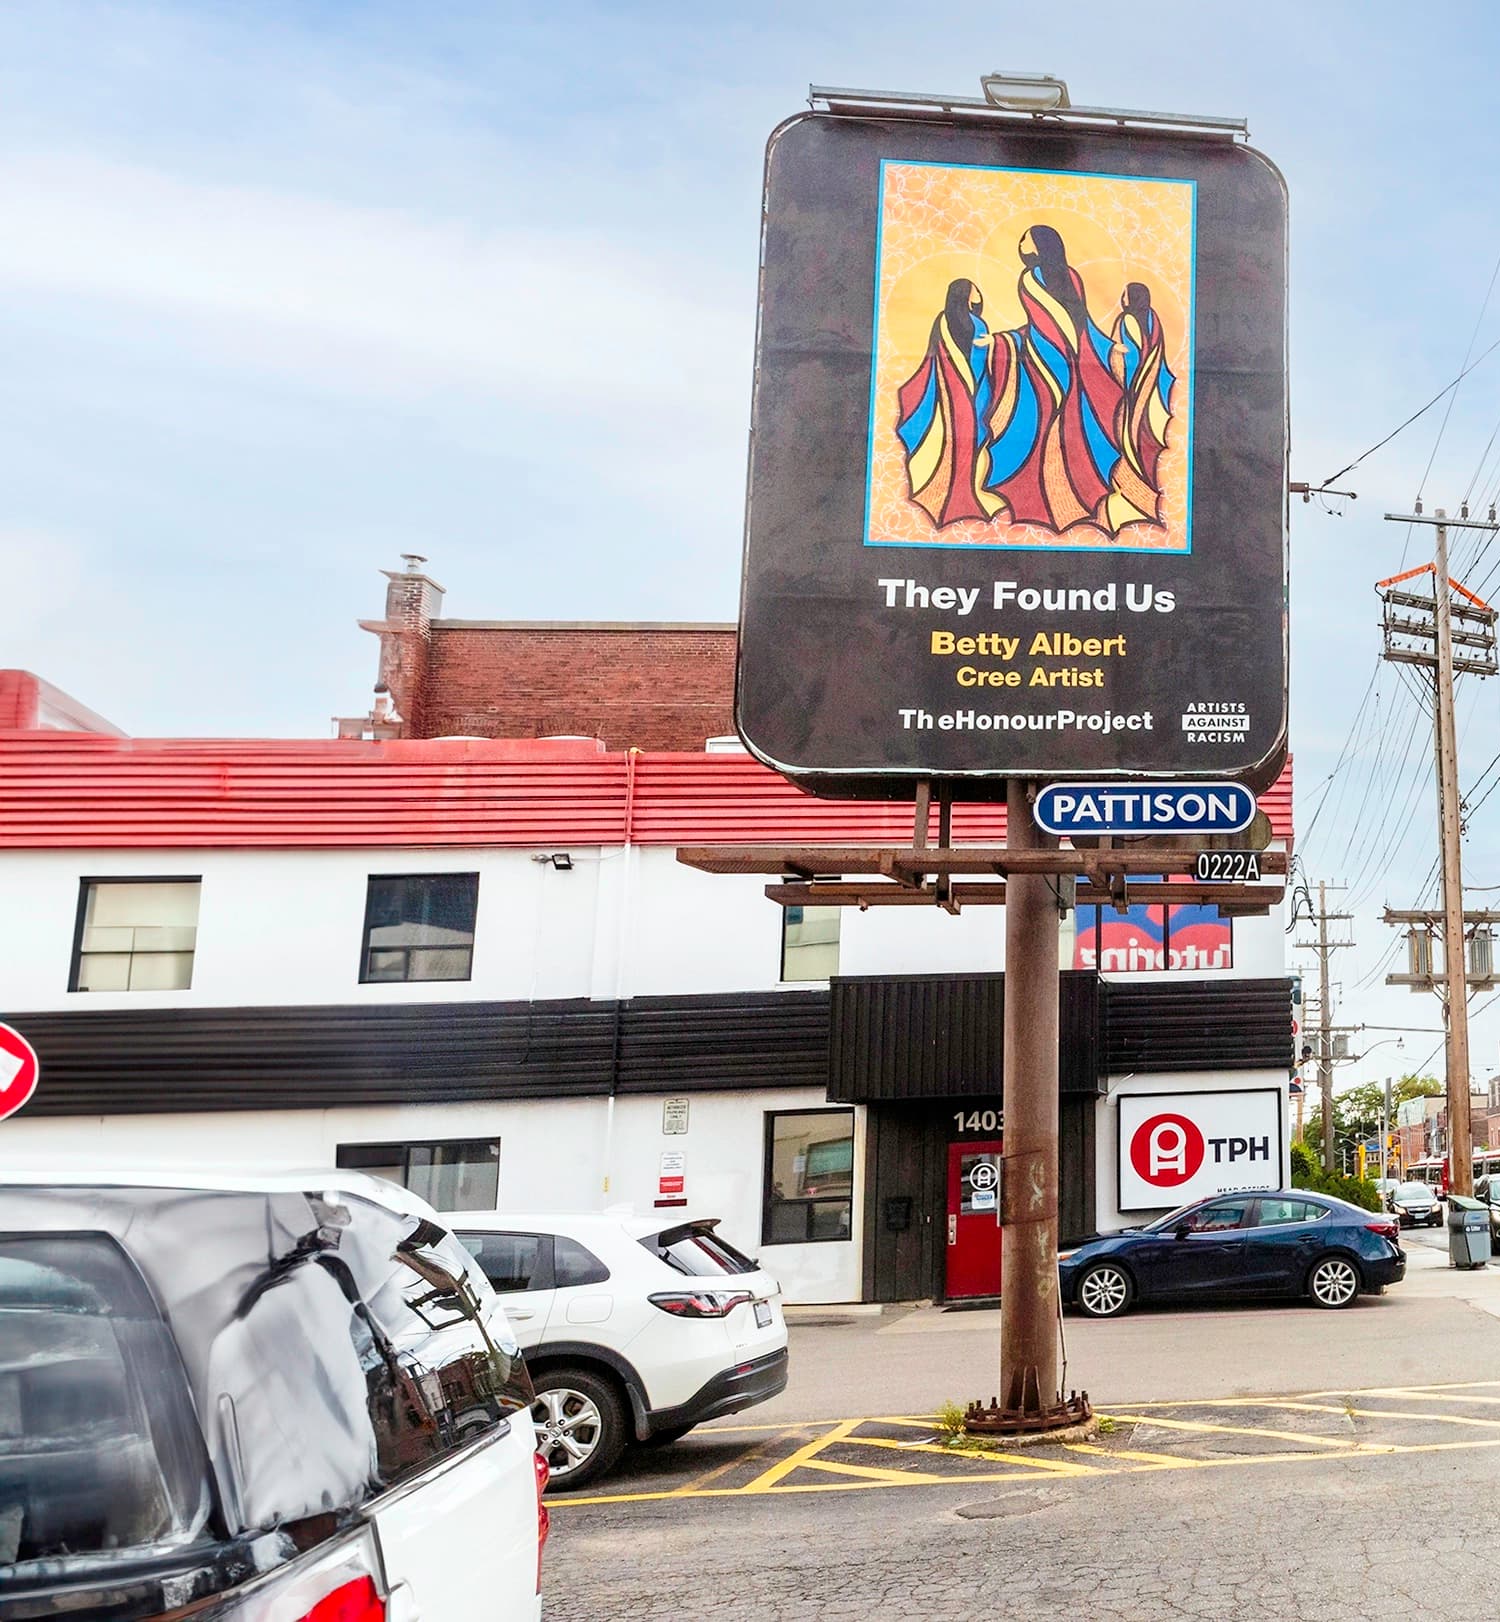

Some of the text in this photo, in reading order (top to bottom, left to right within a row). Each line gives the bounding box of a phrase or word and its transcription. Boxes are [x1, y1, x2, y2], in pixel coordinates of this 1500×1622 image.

[878, 578, 1176, 615] They Found Us
[930, 631, 1127, 660] Betty Albert
[956, 666, 1104, 687] Cree Artist
[898, 708, 1153, 735] TheHonourProject
[1186, 702, 1246, 714] ARTISTS
[1187, 717, 1246, 728] AGAINST
[1187, 732, 1245, 743] RACISM
[1053, 794, 1237, 823] PATTISON
[1198, 853, 1260, 880] 0222A
[1208, 1136, 1269, 1163] TPH
